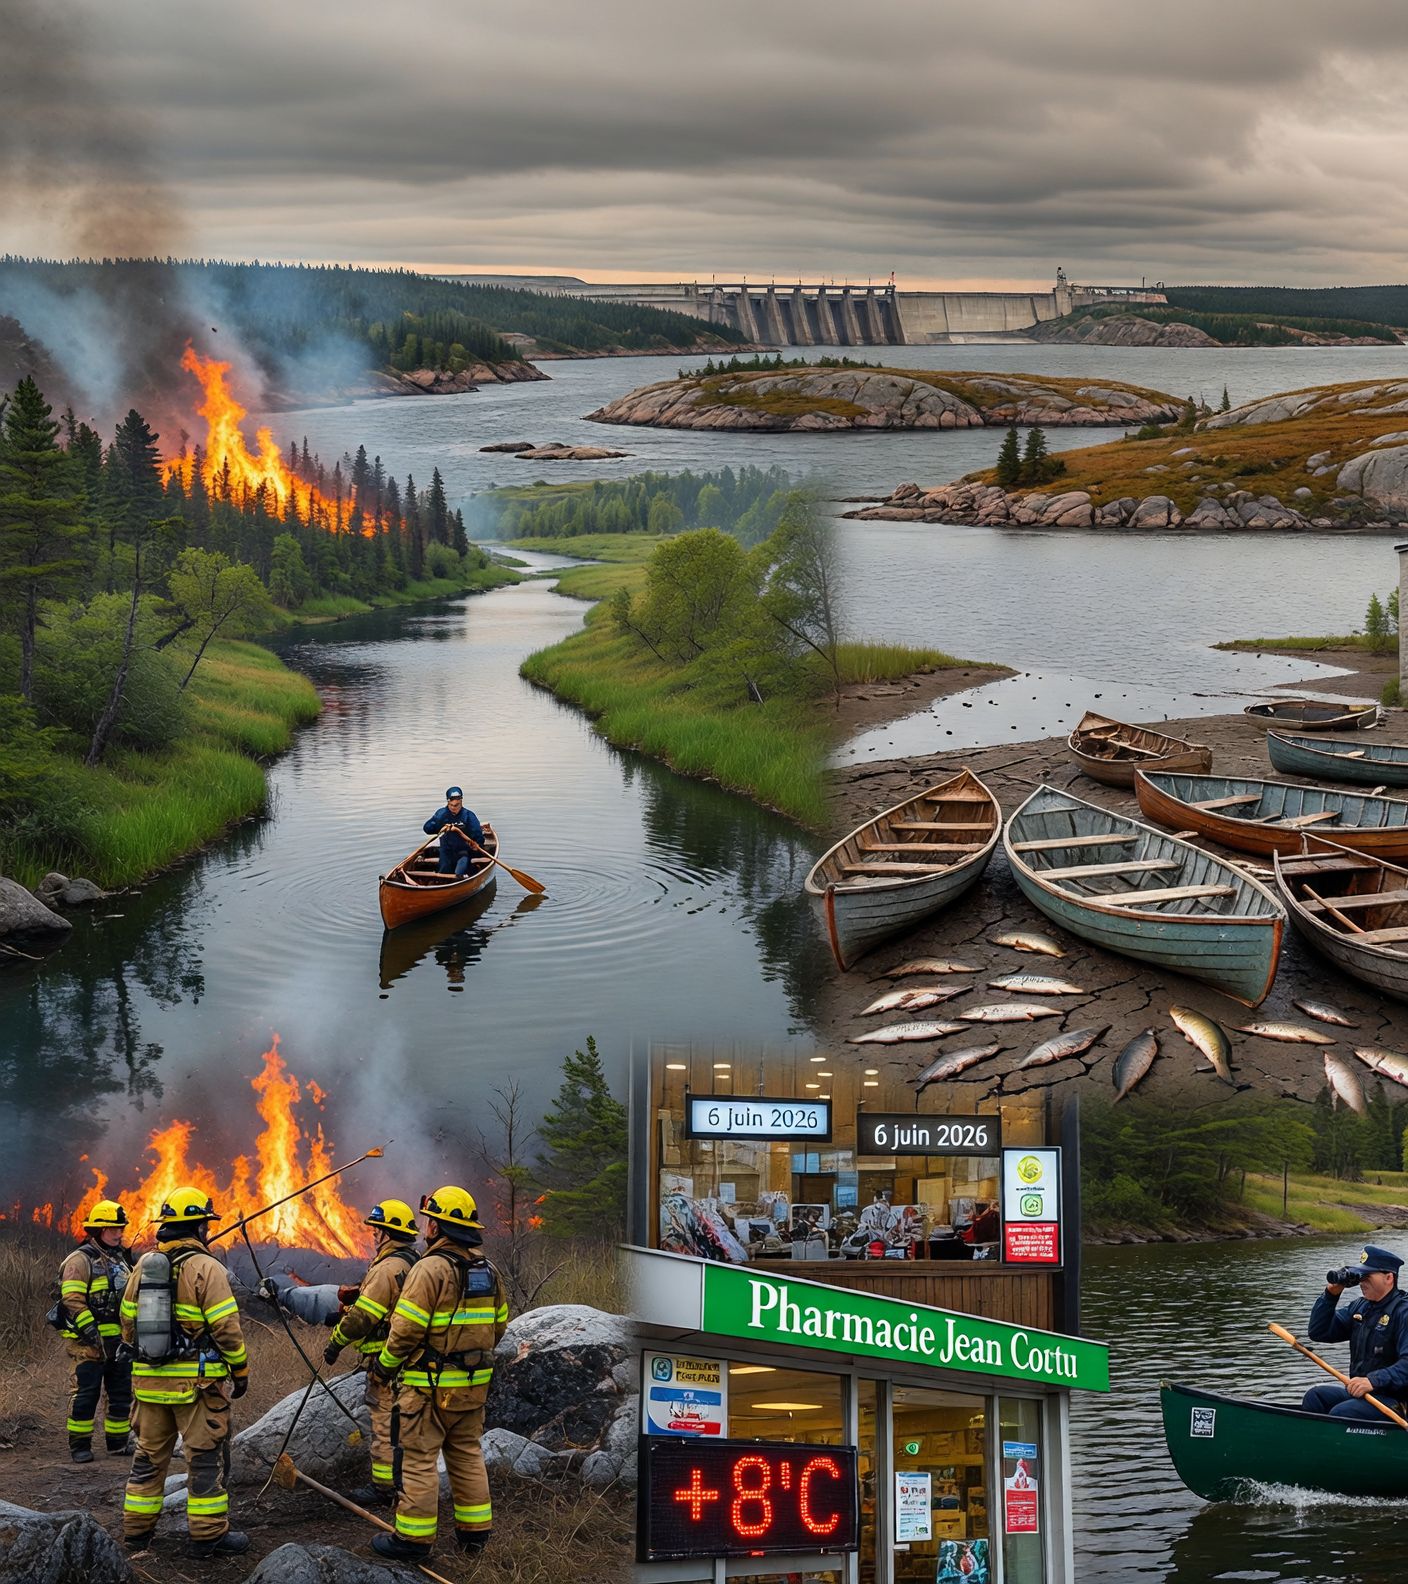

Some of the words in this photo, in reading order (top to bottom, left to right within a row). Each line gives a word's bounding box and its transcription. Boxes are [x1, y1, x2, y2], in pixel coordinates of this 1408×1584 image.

[708, 1107, 720, 1126] 6
[770, 1108, 818, 1128] 2026
[874, 1124, 888, 1145] 6
[891, 1124, 930, 1150] juin
[937, 1124, 988, 1146] 2026
[747, 1279, 936, 1355] Pharmacie
[939, 1318, 1003, 1366] Jean
